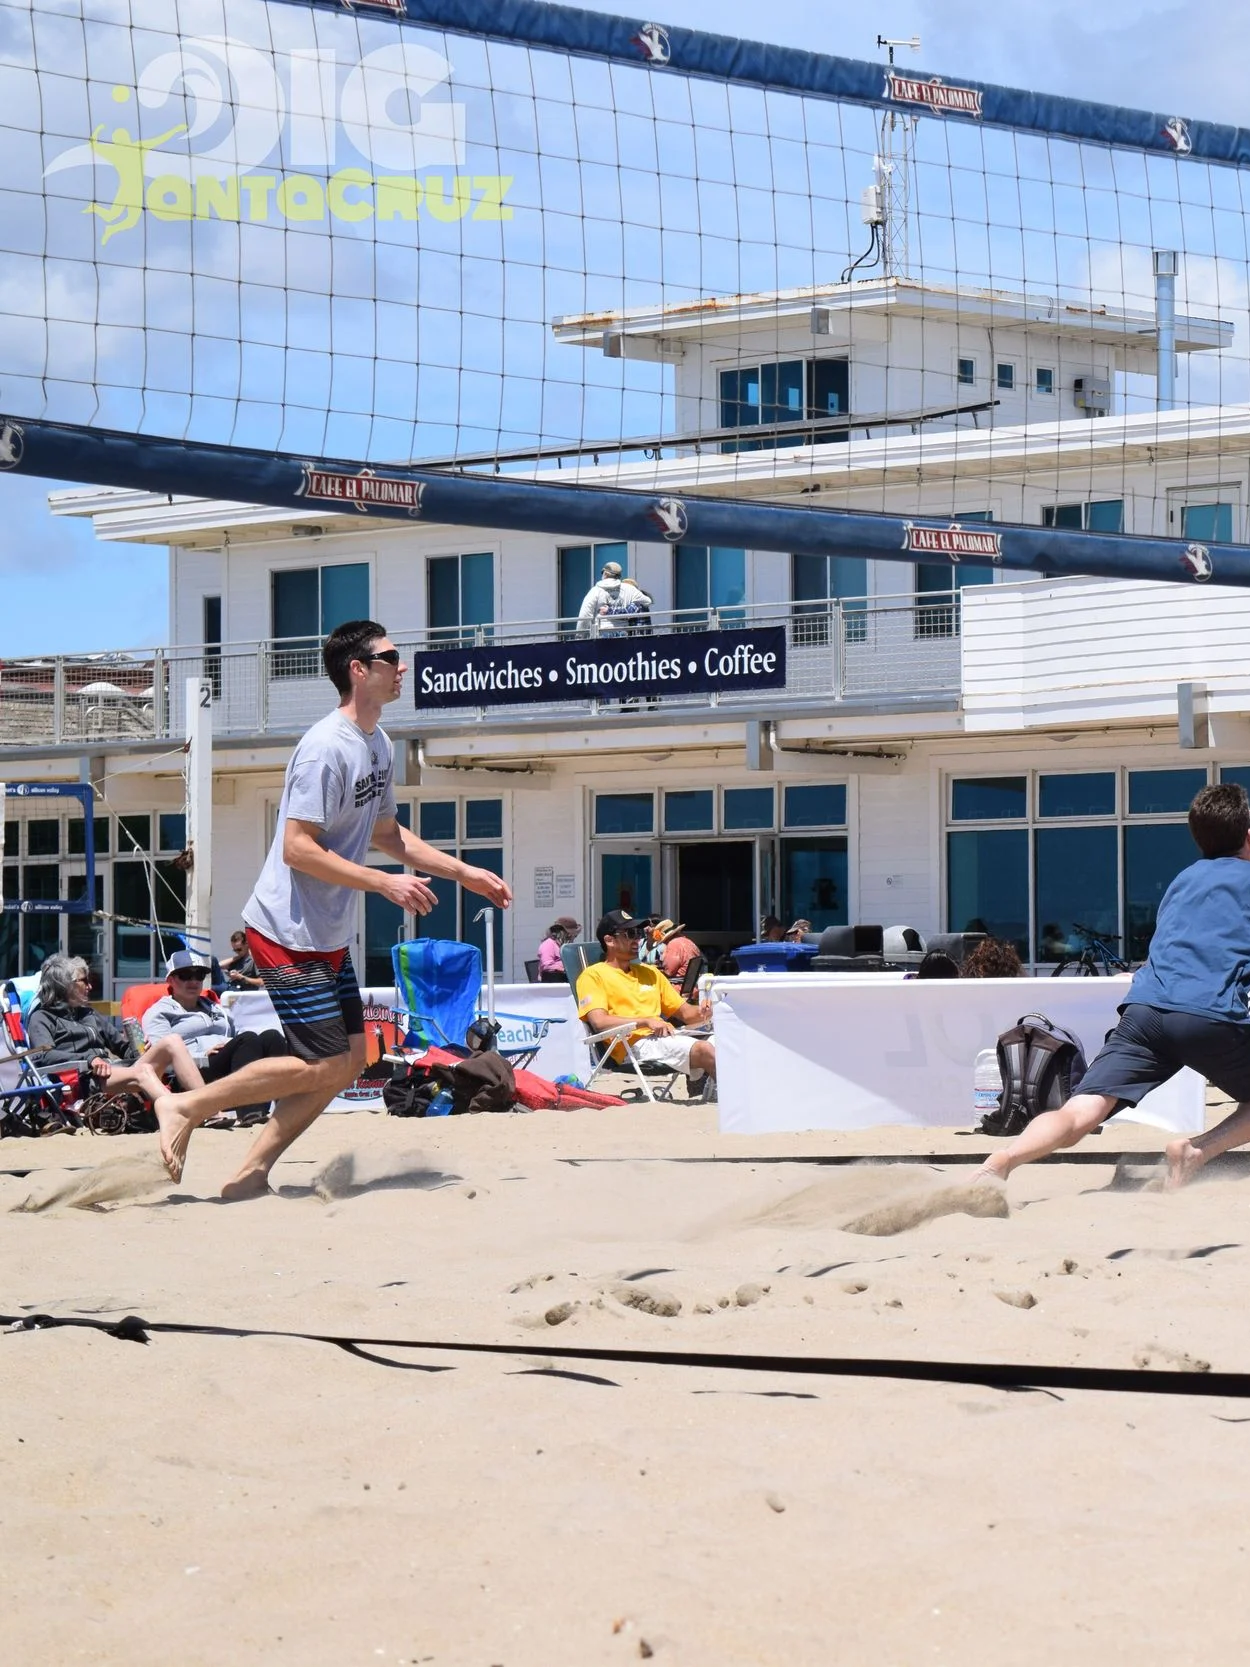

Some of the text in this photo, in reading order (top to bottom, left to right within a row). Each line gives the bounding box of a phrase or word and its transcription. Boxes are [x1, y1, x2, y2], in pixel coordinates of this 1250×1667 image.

[894, 79, 975, 109] CAFE EL PALOMAR
[312, 475, 413, 504] CAFE EL PALOMAR
[912, 530, 995, 553] CAFE EL PALOMAR
[421, 644, 777, 694] Sandwiches Smoothies Coffee
[200, 686, 211, 708] 2
[497, 1024, 533, 1043] each
